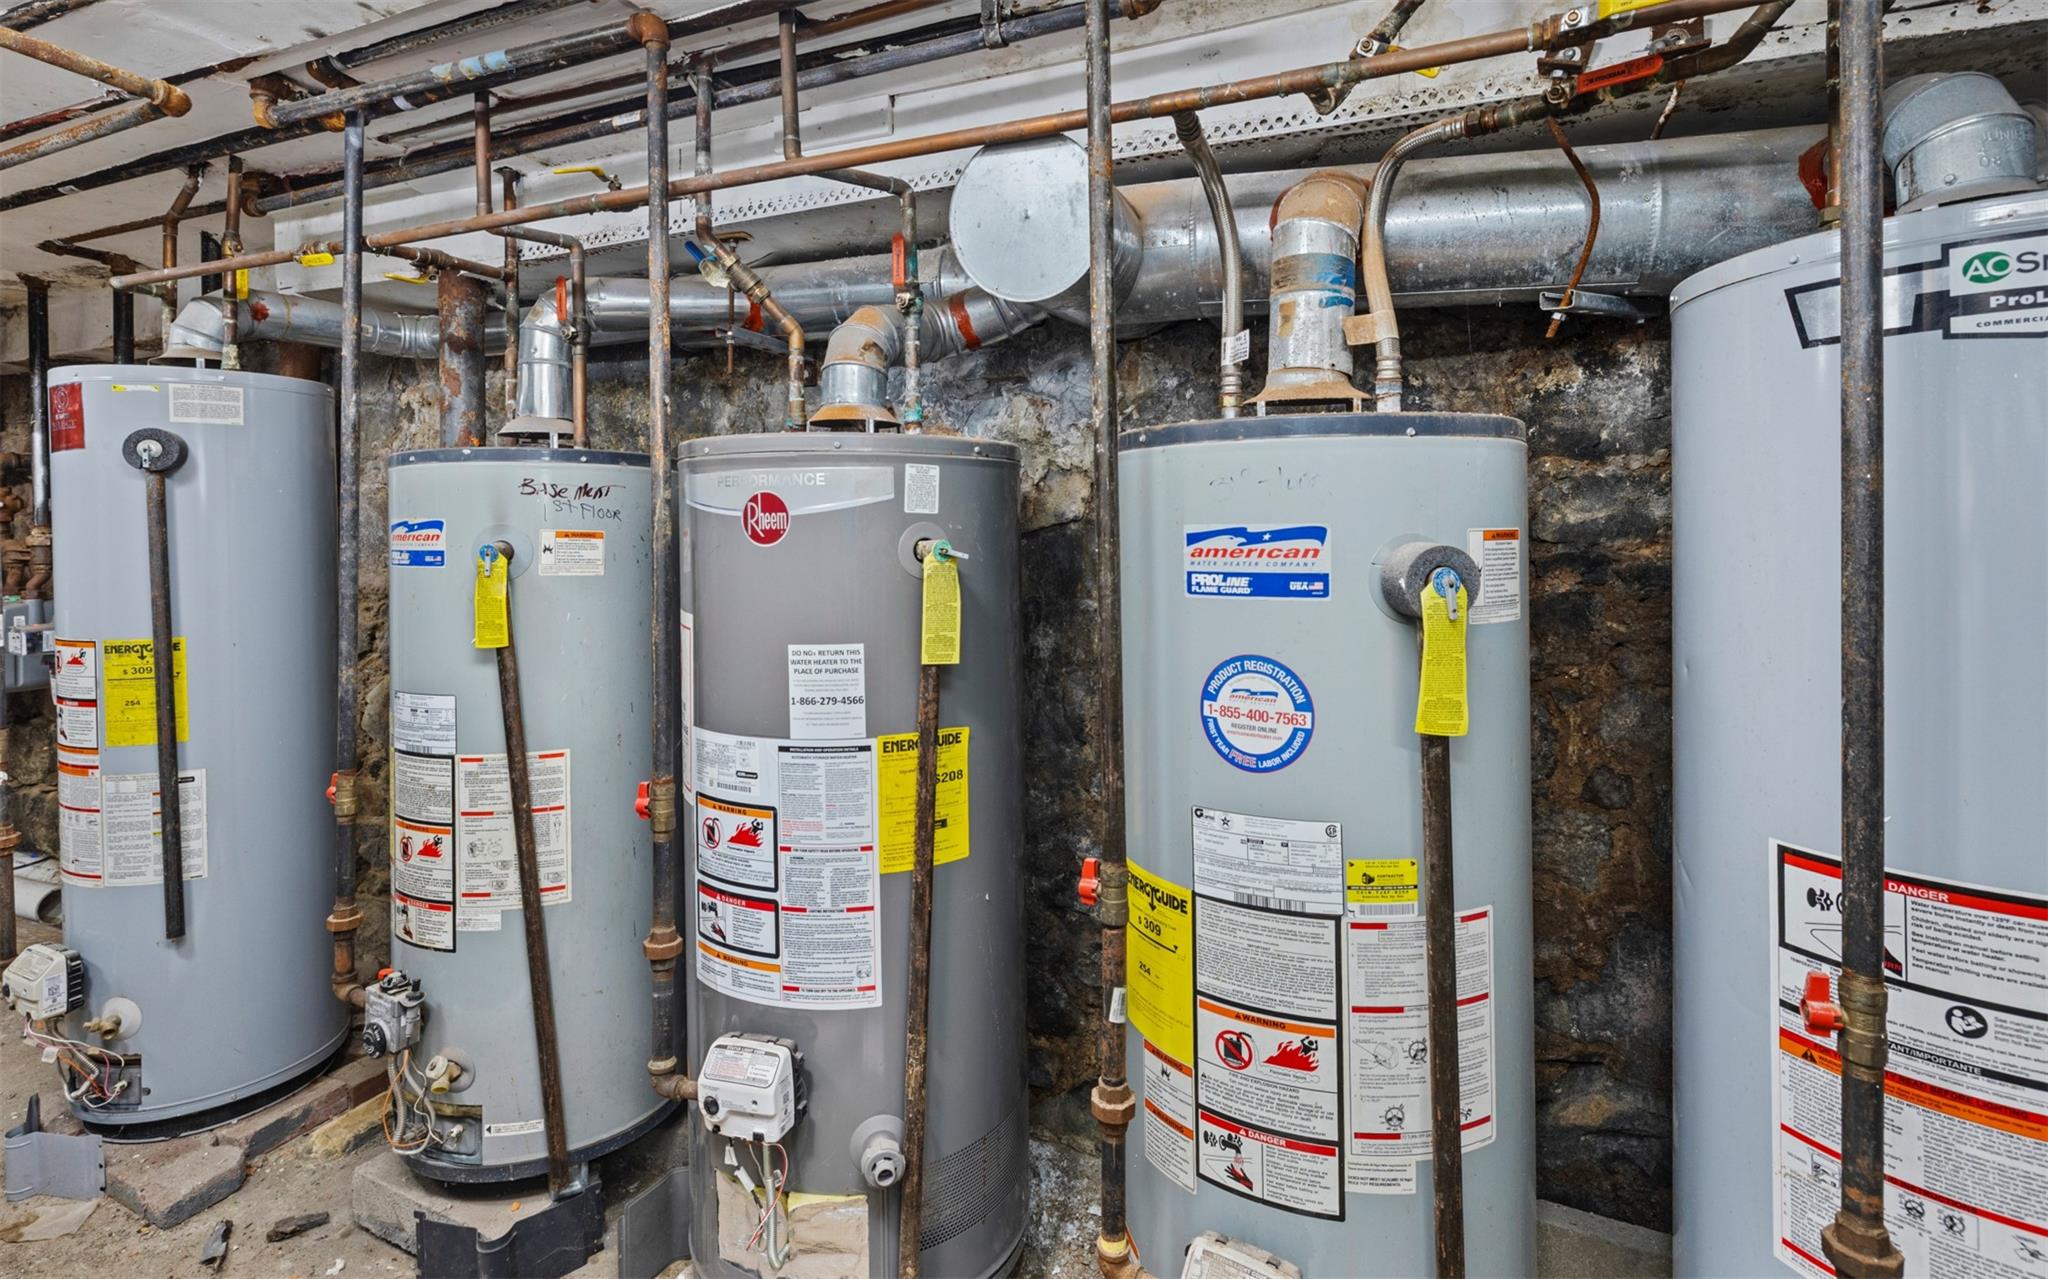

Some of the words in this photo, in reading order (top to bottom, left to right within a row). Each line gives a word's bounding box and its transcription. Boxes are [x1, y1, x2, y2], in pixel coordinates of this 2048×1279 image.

[716, 473, 826, 488] PERFORMANCE
[747, 492, 787, 538] Rheem
[1190, 547, 1321, 559] american
[104, 642, 180, 655] ENERGYGE
[791, 649, 802, 657] DO
[818, 649, 845, 657] RETURN
[131, 666, 153, 675] 309
[790, 658, 811, 666] WATER
[794, 667, 813, 675] PLACE
[1207, 661, 1242, 694] PRODUCT
[1244, 660, 1306, 704] REGISTRATION
[791, 695, 864, 706] 1-866-279-4566
[1207, 704, 1306, 726] 1-855-400-7563
[1231, 722, 1256, 731] REGISTER
[1258, 724, 1277, 733] ONLINE
[883, 732, 962, 755] ENERGUIDE
[1207, 718, 1217, 738] FIRST
[1215, 736, 1230, 755] YEAR
[1229, 748, 1257, 767] FREE
[1258, 756, 1282, 768] LABOR
[1281, 731, 1305, 761] INCLUDED
[718, 805, 747, 815] WARNING
[722, 895, 746, 906] DANGER
[1888, 882, 1949, 903] DANGER
[1911, 900, 1930, 908] Water
[1931, 904, 1972, 917] temperature
[1974, 912, 1989, 920] over
[1143, 916, 1161, 937] 309
[1911, 907, 1932, 915] severe
[1934, 911, 1954, 920] burns
[1955, 915, 1985, 927] instantly
[1996, 922, 2016, 931] death
[2018, 927, 2035, 935] from
[1911, 916, 1941, 927] Children,
[1943, 923, 1972, 933] disabled
[1974, 928, 1987, 936] and
[1988, 931, 2012, 942] elderly
[1934, 926, 1952, 936] being
[1911, 938, 1951, 951] temperature
[1962, 947, 1980, 957] water
[1925, 933, 1961, 947] instruction
[1963, 940, 1988, 951] manual
[1990, 945, 2013, 957] before
[2015, 952, 2040, 963] setting
[723, 954, 748, 967] WARNING
[1911, 946, 1926, 954] Feel
[1927, 950, 1945, 958] water
[1947, 953, 1968, 963] before
[1970, 958, 1997, 971] bathing
[1911, 956, 1953, 970] Temperature
[1982, 971, 2004, 982] valves
[1240, 1014, 1287, 1030] WARNING
[1248, 1130, 1287, 1147] DANGER
